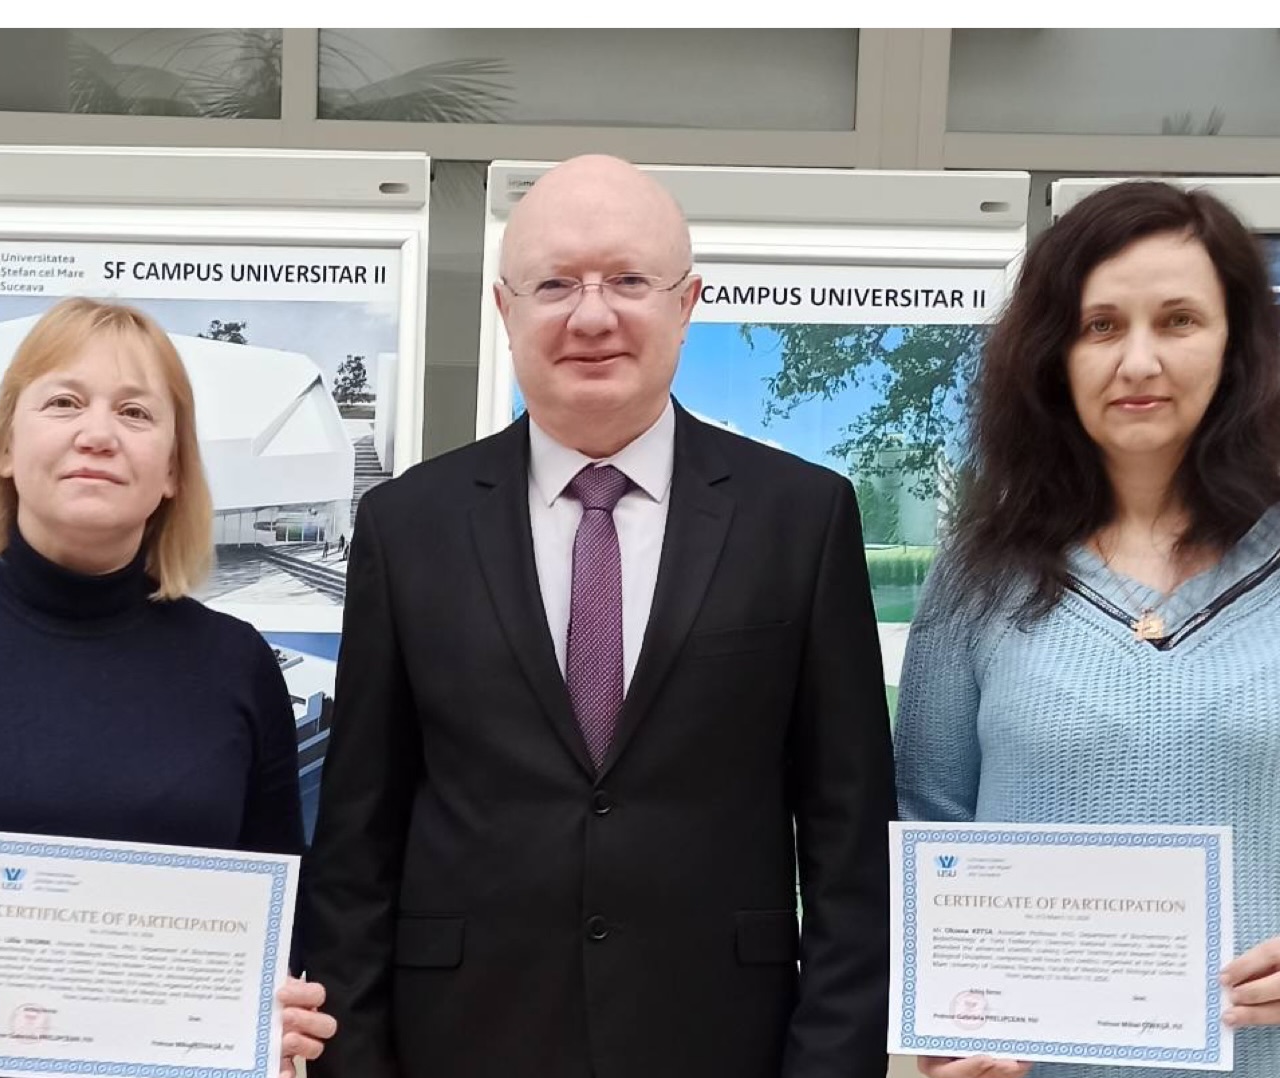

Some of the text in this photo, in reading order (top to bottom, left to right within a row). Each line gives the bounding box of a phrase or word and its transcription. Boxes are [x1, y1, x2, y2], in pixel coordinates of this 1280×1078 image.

[0, 252, 76, 264] Universitatea
[38, 268, 55, 279] cel
[57, 268, 85, 279] Mare
[104, 260, 387, 285] SF CAMPUS UNIVERSITAR II
[0, 281, 45, 293] Suceava
[700, 285, 986, 309] CAMPUS UNIVERSITAR II
[933, 894, 1186, 913] CERTIFICATE OF PARTICIPATION
[102, 911, 125, 926] OF
[128, 912, 248, 934] PARTICIPATION
